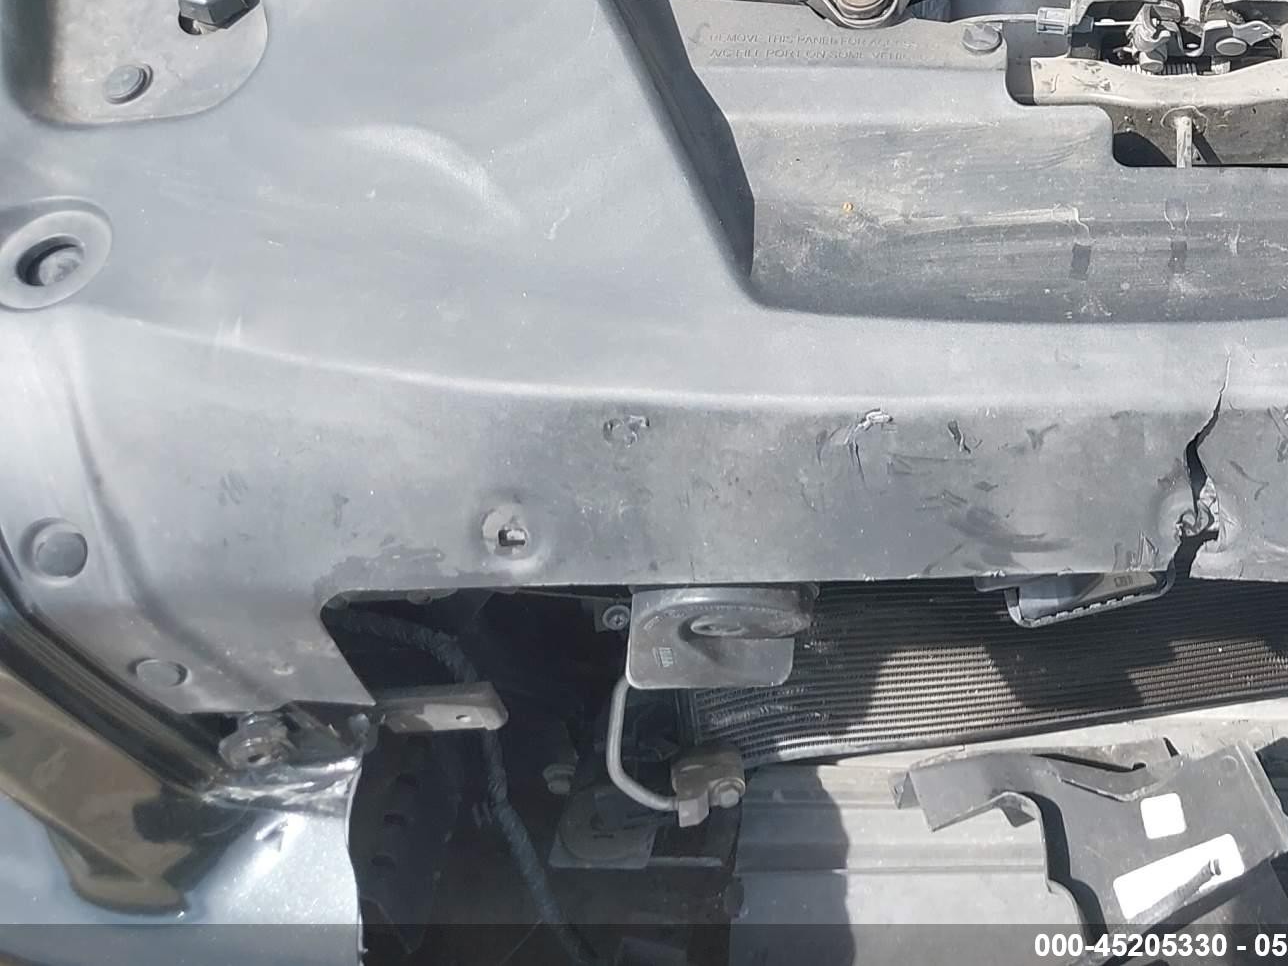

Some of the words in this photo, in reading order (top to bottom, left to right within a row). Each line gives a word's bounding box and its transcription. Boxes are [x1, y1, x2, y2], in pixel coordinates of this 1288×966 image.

[768, 34, 794, 43] THIS
[797, 35, 838, 44] PANEL
[841, 36, 865, 45] FOR
[736, 49, 760, 58] FILL
[766, 49, 801, 58] PORT
[806, 50, 826, 59] ON
[830, 50, 864, 59] SOME
